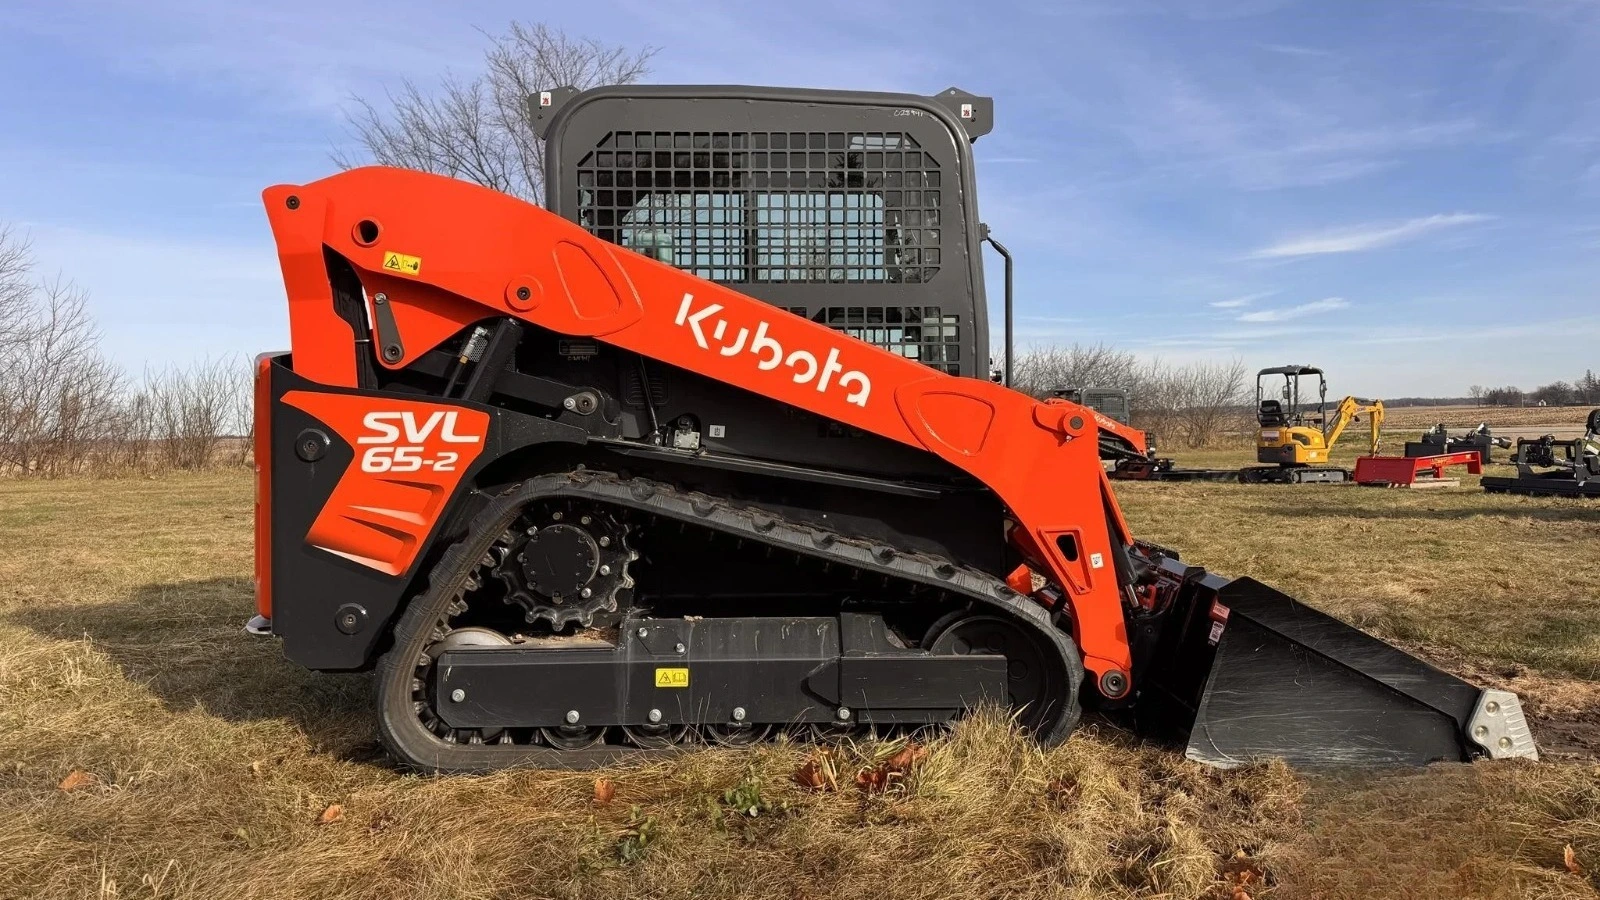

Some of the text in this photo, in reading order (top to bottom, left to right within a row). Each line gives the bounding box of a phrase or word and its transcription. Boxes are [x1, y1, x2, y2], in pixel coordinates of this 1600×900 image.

[674, 292, 871, 408] Kubota
[357, 411, 480, 444] SVL
[361, 446, 459, 473] 65-2
